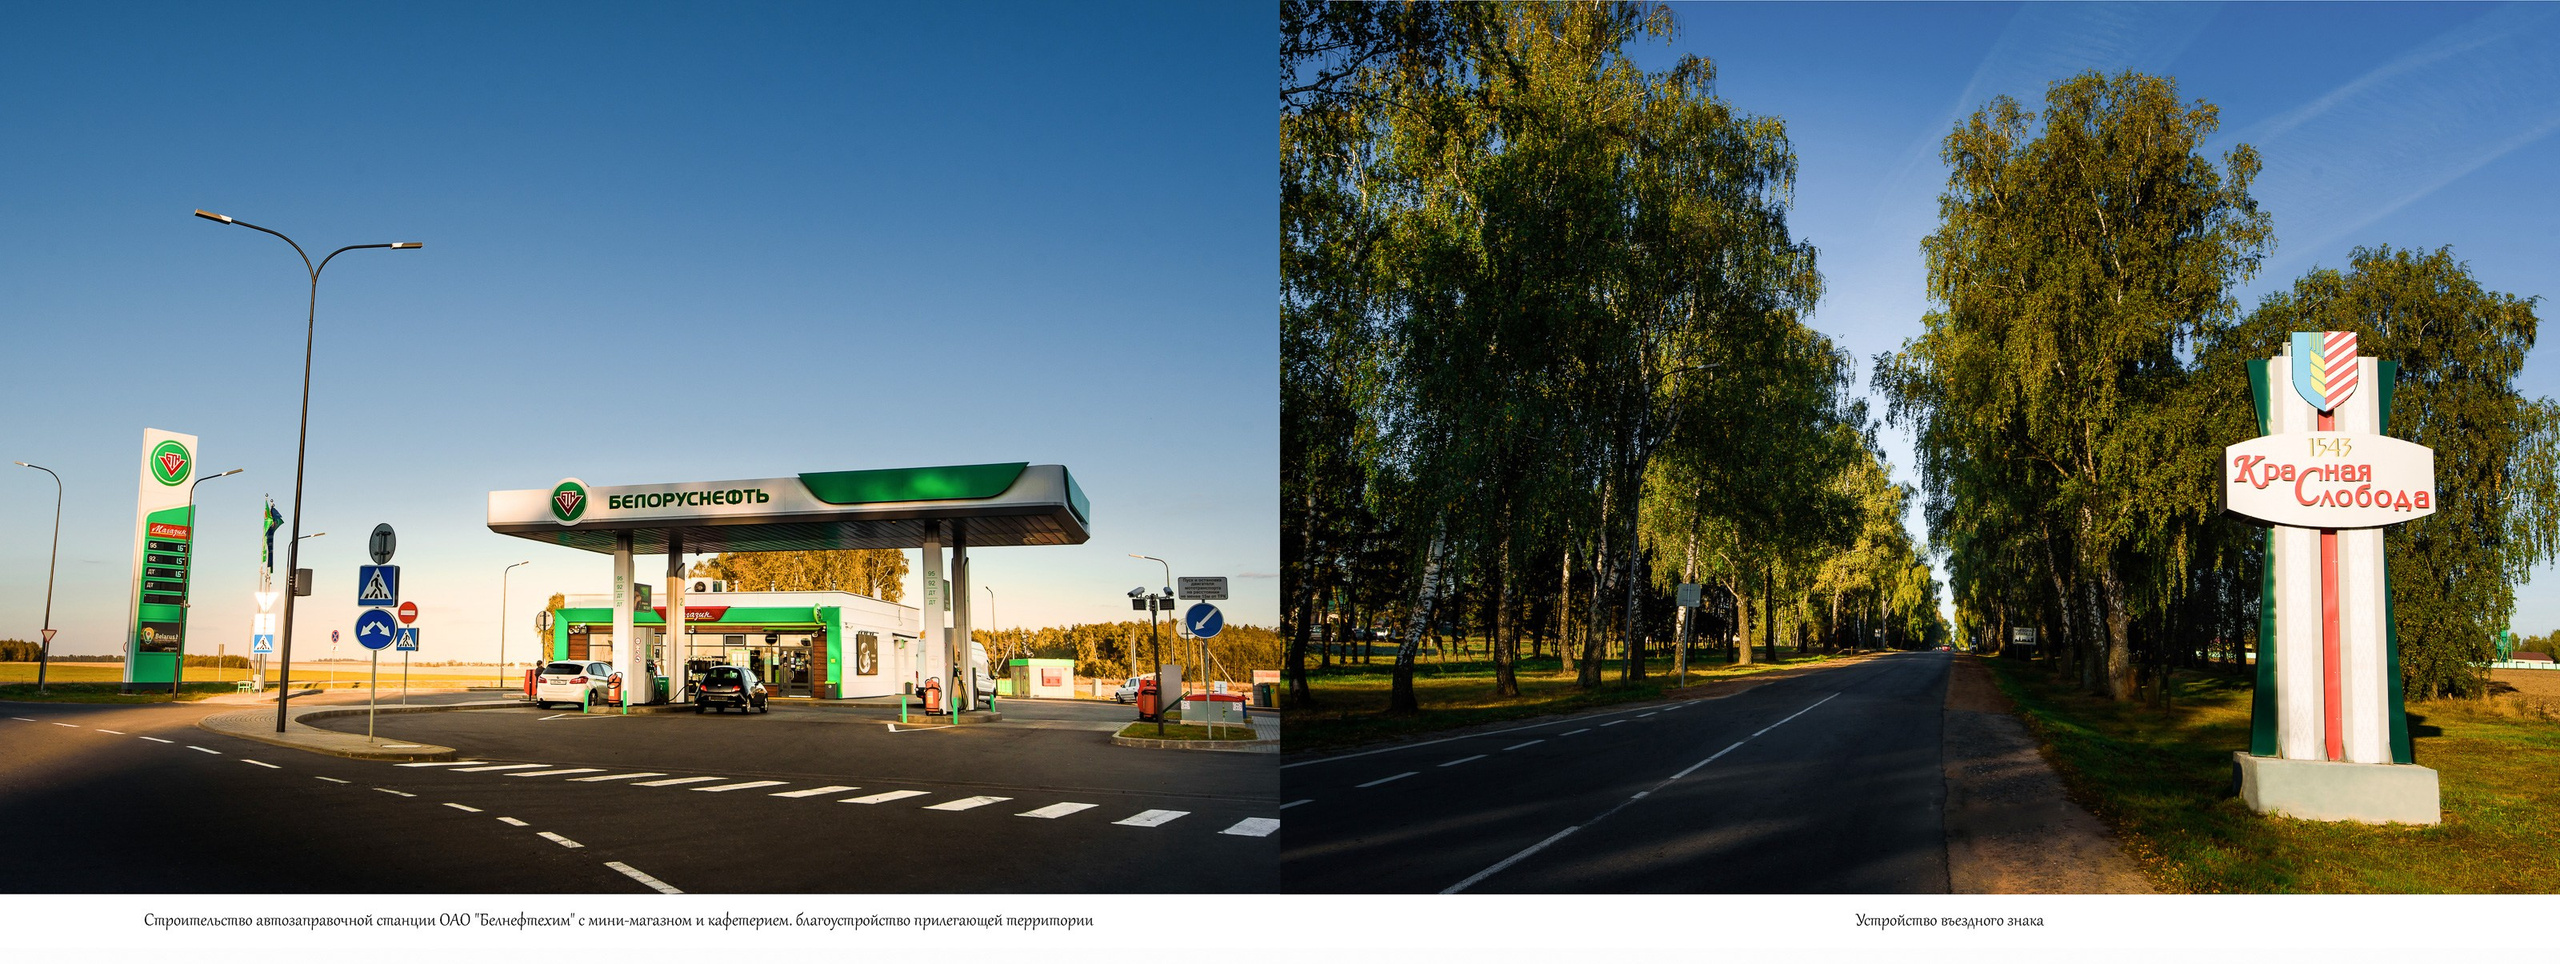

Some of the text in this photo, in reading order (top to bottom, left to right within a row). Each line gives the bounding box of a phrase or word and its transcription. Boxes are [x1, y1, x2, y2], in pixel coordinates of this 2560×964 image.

[2307, 437, 2352, 457] 1543
[609, 488, 770, 509] БЕЛОРУСНЕФТЬ
[679, 597, 683, 606] 2
[685, 611, 713, 621] газин
